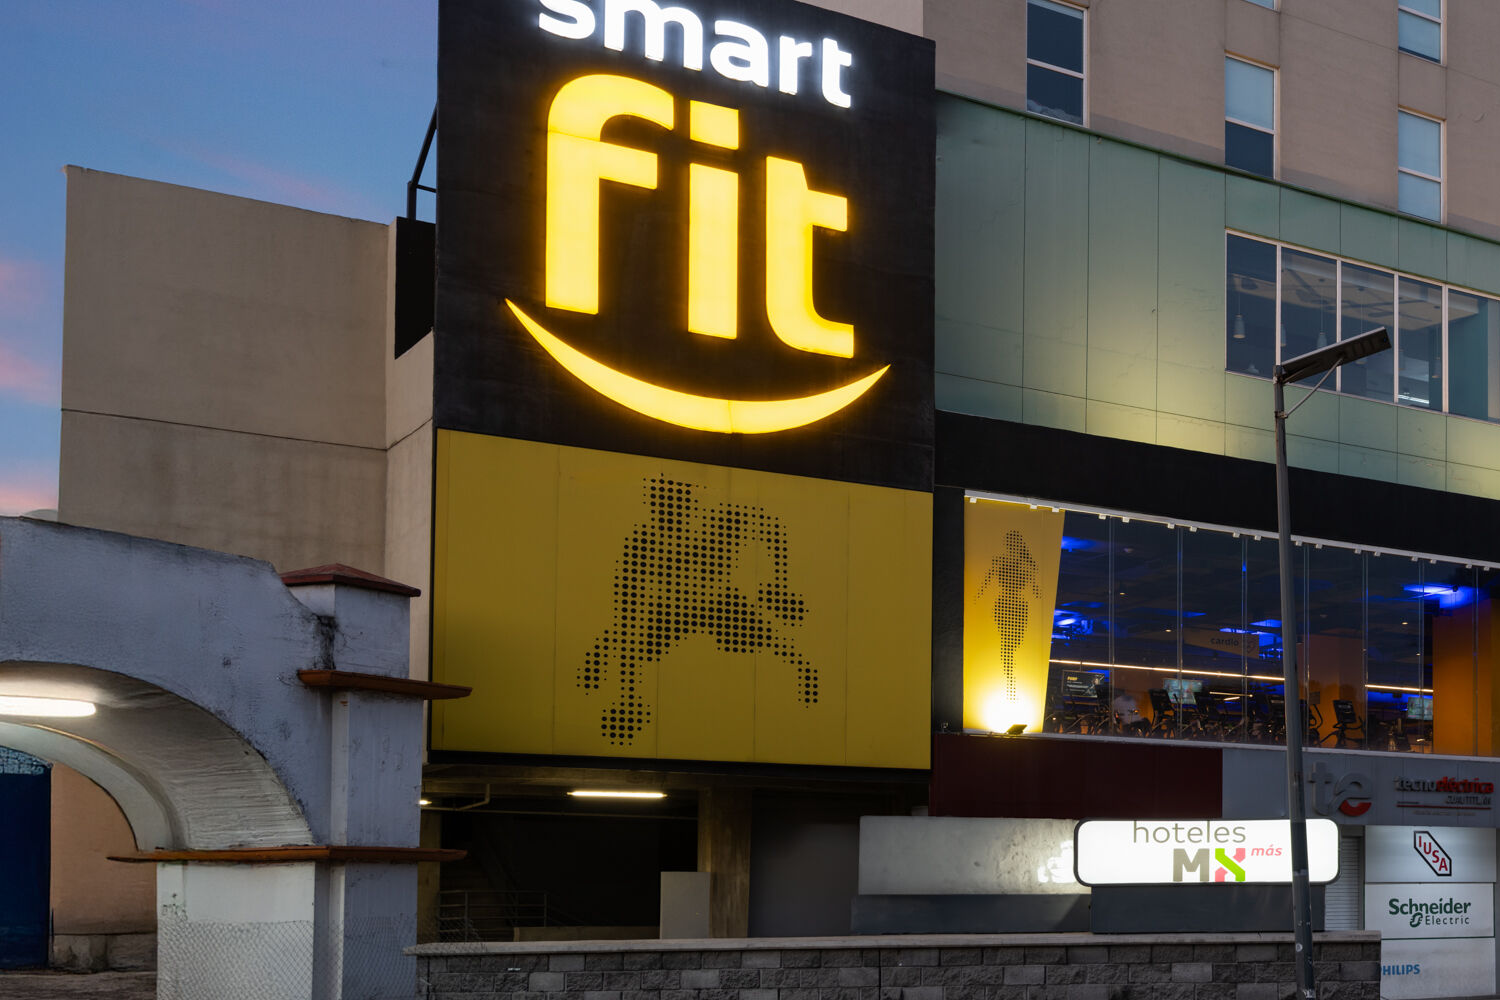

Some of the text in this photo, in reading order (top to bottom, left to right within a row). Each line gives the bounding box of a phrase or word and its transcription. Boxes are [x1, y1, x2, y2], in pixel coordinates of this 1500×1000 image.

[544, 72, 855, 360] fit
[1209, 637, 1240, 646] cardio
[1132, 820, 1247, 844] hoteles
[1250, 844, 1283, 857] más
[1418, 835, 1448, 872] IUSA
[1388, 898, 1472, 916] Schneider
[1425, 915, 1470, 926] Electric
[1381, 963, 1421, 976] HILIPS
